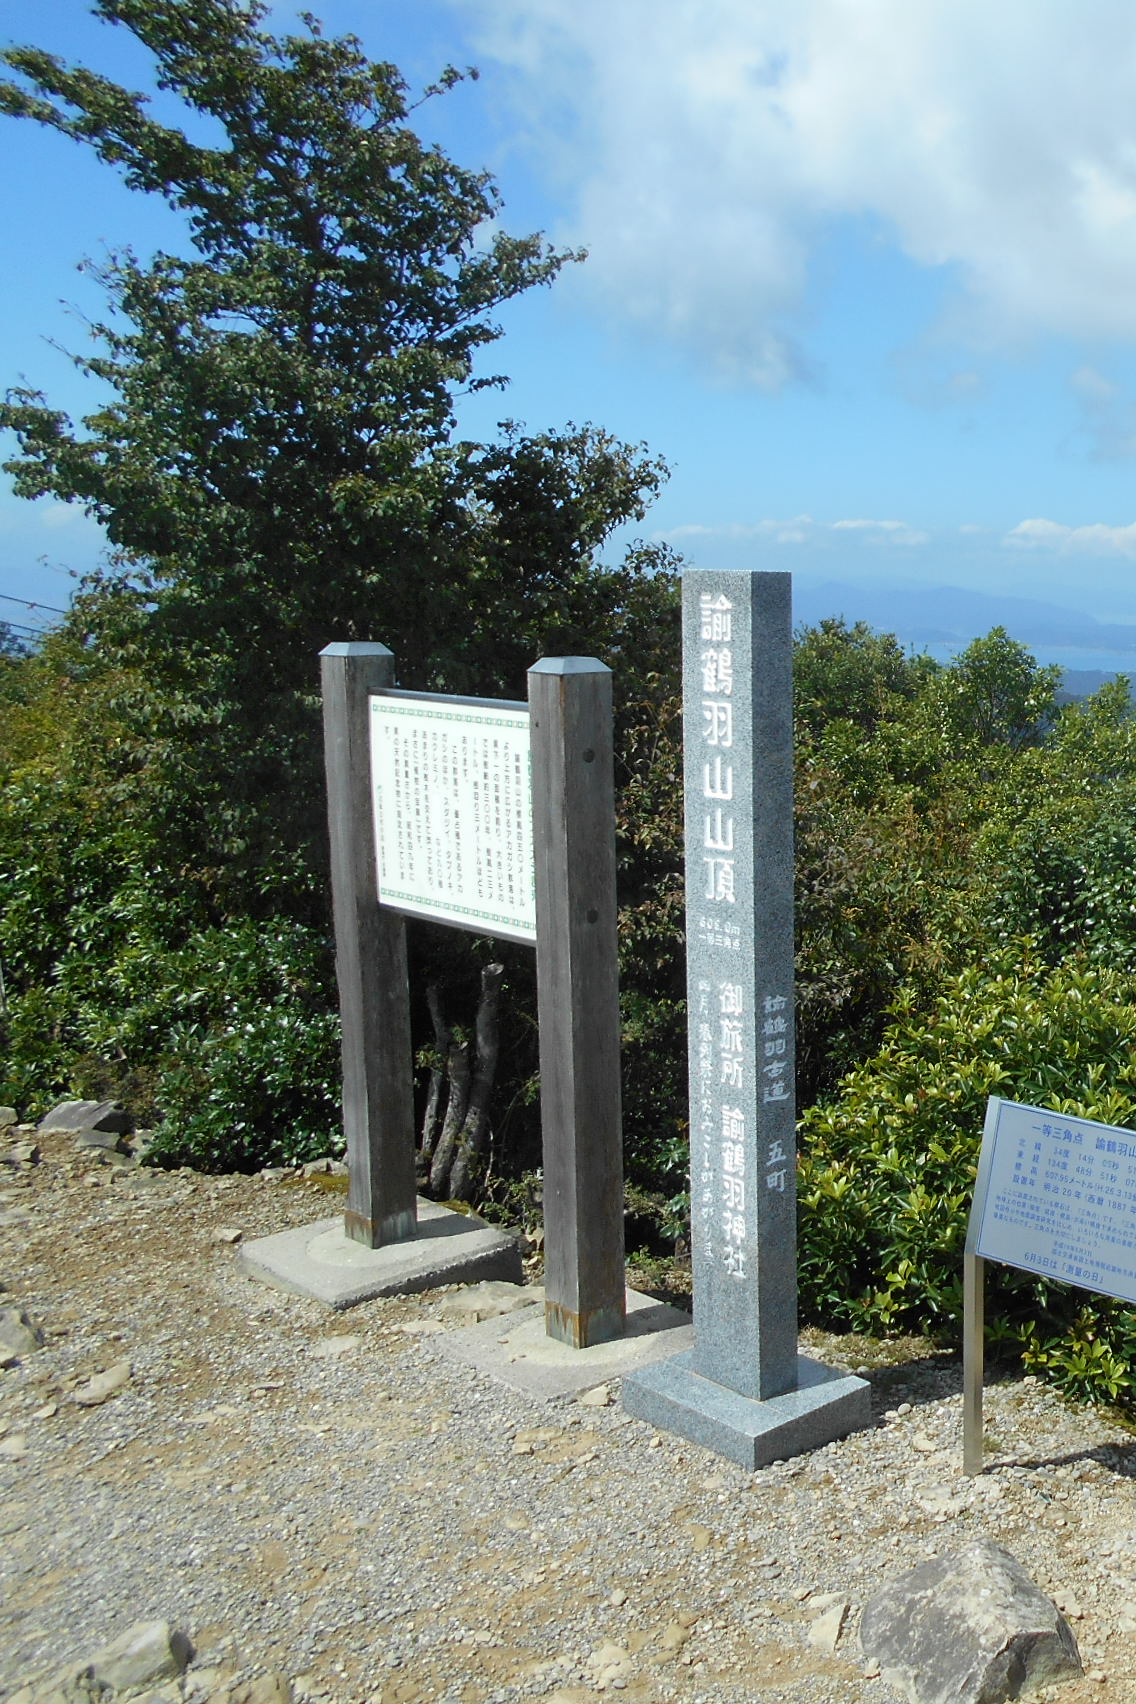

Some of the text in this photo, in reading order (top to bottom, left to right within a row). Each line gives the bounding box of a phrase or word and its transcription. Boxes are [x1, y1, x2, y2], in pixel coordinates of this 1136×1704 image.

[701, 593, 736, 904] 諭鶴羽山山頂
[719, 982, 746, 1279] 御旅所 諭鶴羽神社
[762, 996, 791, 1192] 諭鶴羽古道 五町
[1031, 1123, 1084, 1146] 一等三角点
